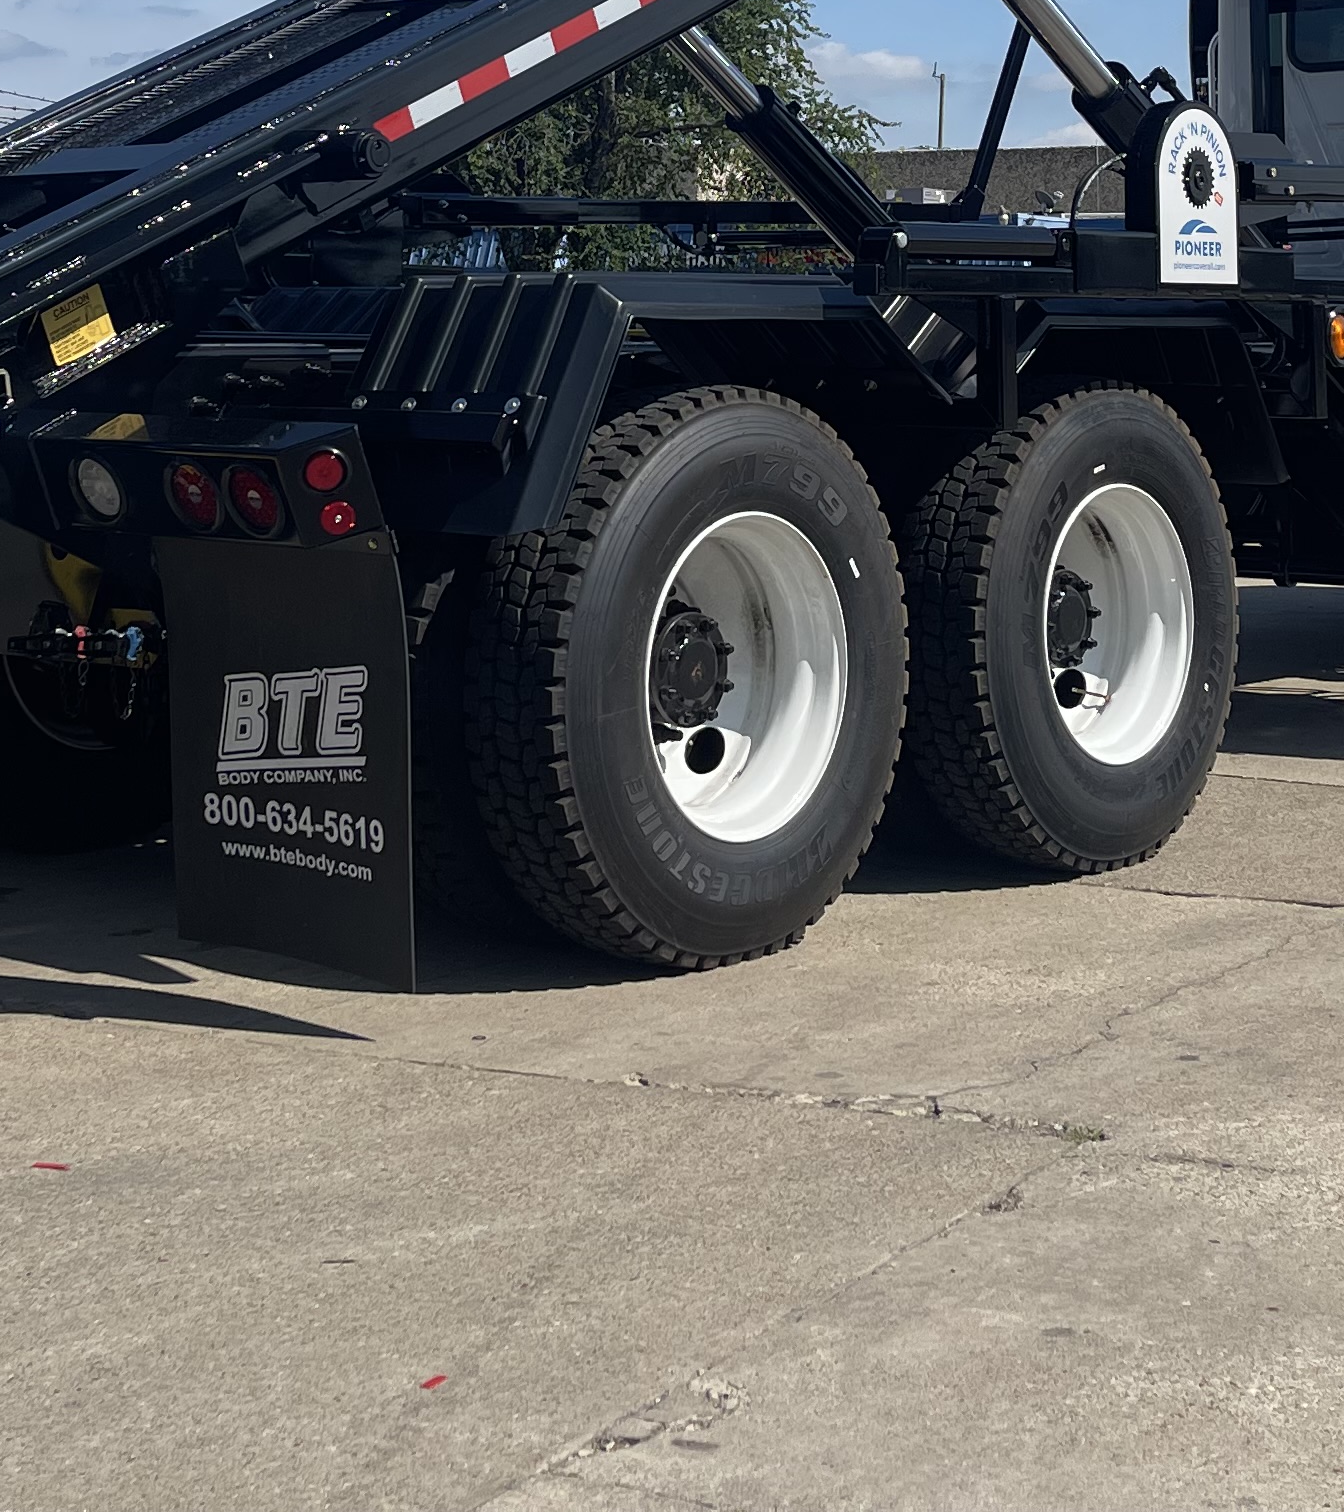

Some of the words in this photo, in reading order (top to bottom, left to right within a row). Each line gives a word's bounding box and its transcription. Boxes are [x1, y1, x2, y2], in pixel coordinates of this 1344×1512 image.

[1168, 127, 1189, 175] RACK
[1199, 123, 1227, 178] PINION
[1174, 240, 1223, 257] PIONEER
[53, 292, 90, 318] CAUTION
[718, 450, 850, 529] M799
[218, 665, 368, 760] BTE
[218, 771, 259, 786] BODY
[263, 769, 337, 785] COMPANY,
[339, 768, 368, 783] INC.
[204, 792, 385, 854] 800-634-5619
[221, 841, 373, 882] www.btebody.com
